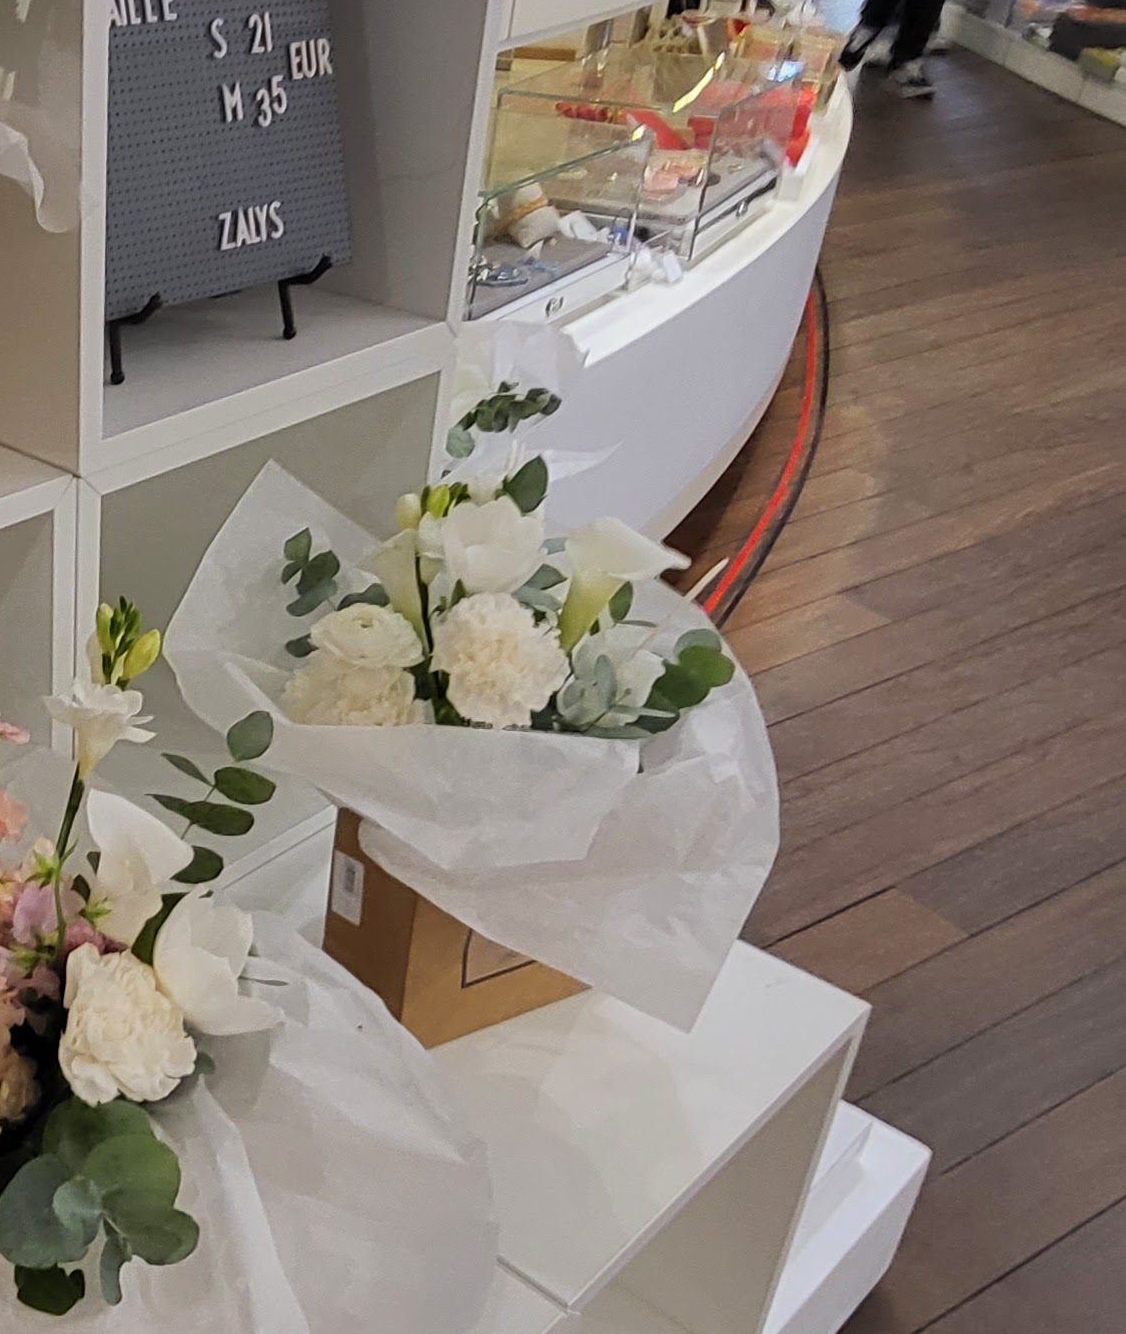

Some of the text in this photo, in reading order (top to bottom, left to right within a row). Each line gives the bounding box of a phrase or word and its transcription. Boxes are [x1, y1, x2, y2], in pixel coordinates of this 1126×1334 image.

[210, 11, 273, 59] S 21
[289, 38, 333, 80] EUR
[223, 74, 287, 127] M 35
[219, 200, 284, 251] ZALYS
